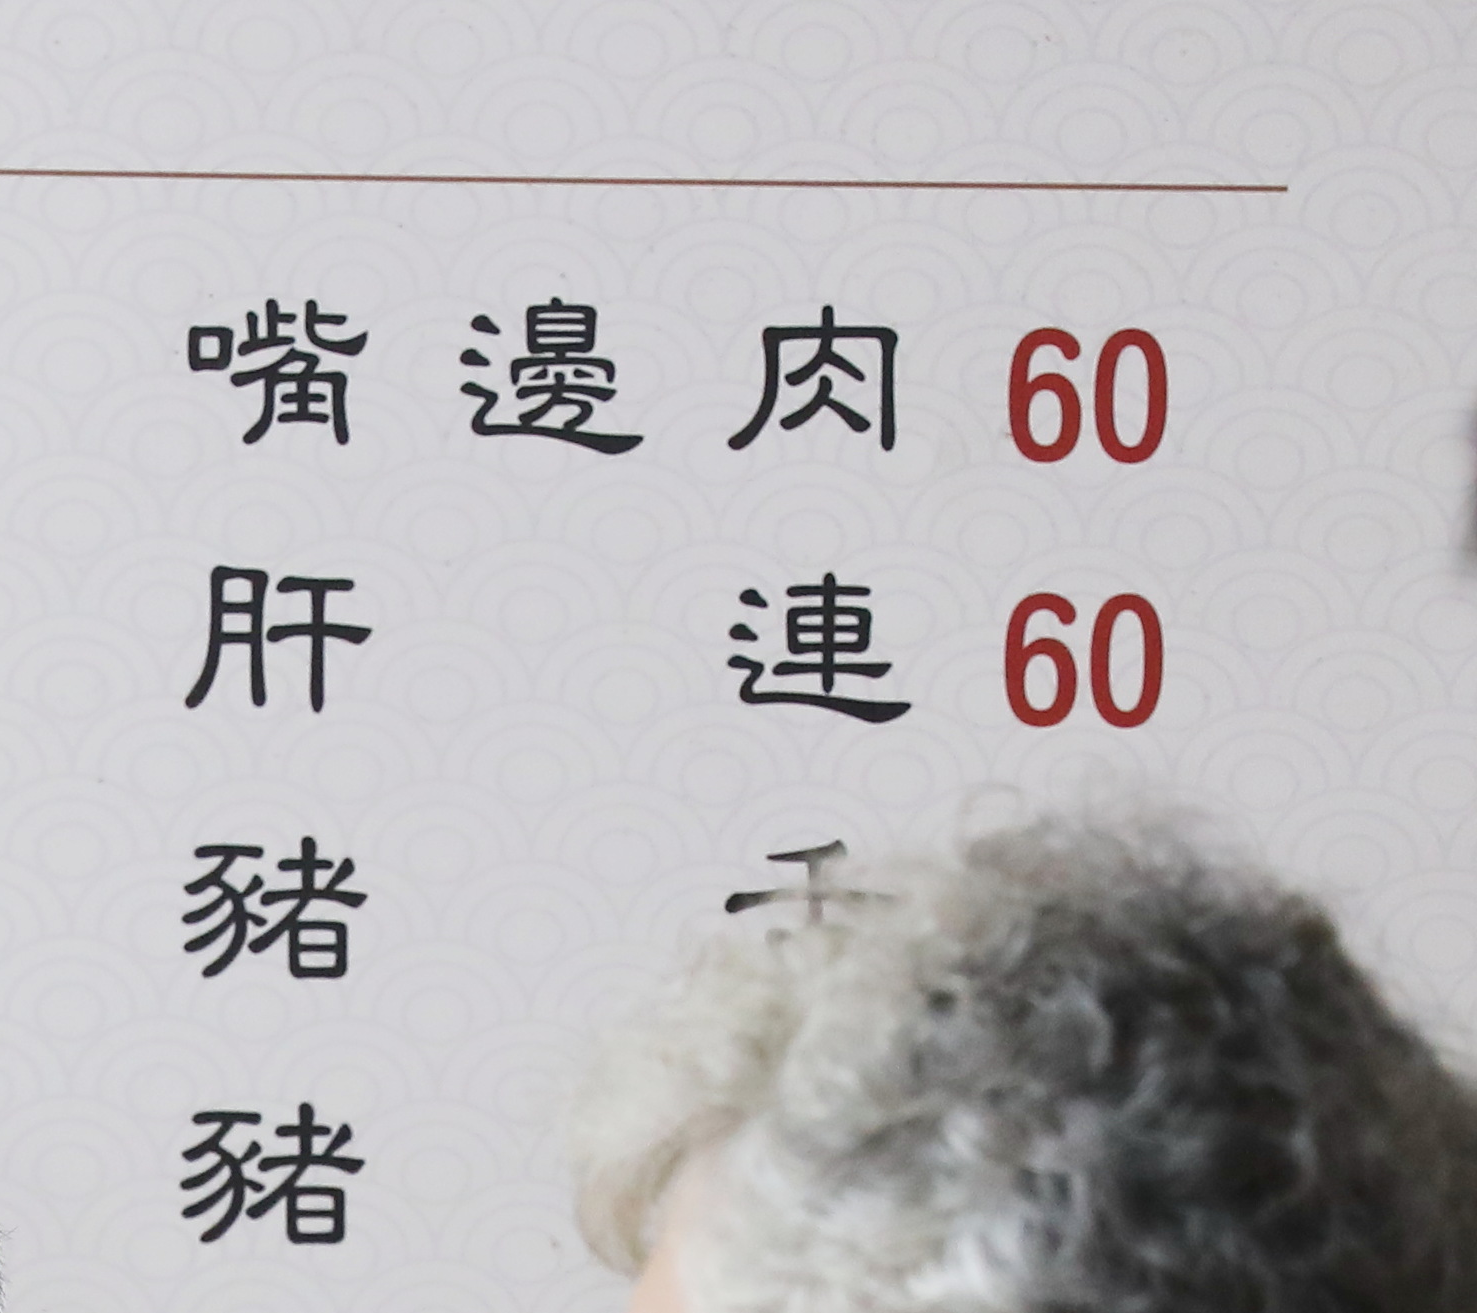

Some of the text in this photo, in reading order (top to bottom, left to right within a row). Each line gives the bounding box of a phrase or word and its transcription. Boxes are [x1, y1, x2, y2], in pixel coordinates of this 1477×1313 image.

[186, 297, 1168, 464] 嘴邊肉 60
[1004, 592, 1163, 729] 60
[179, 1102, 365, 1245] 豬
